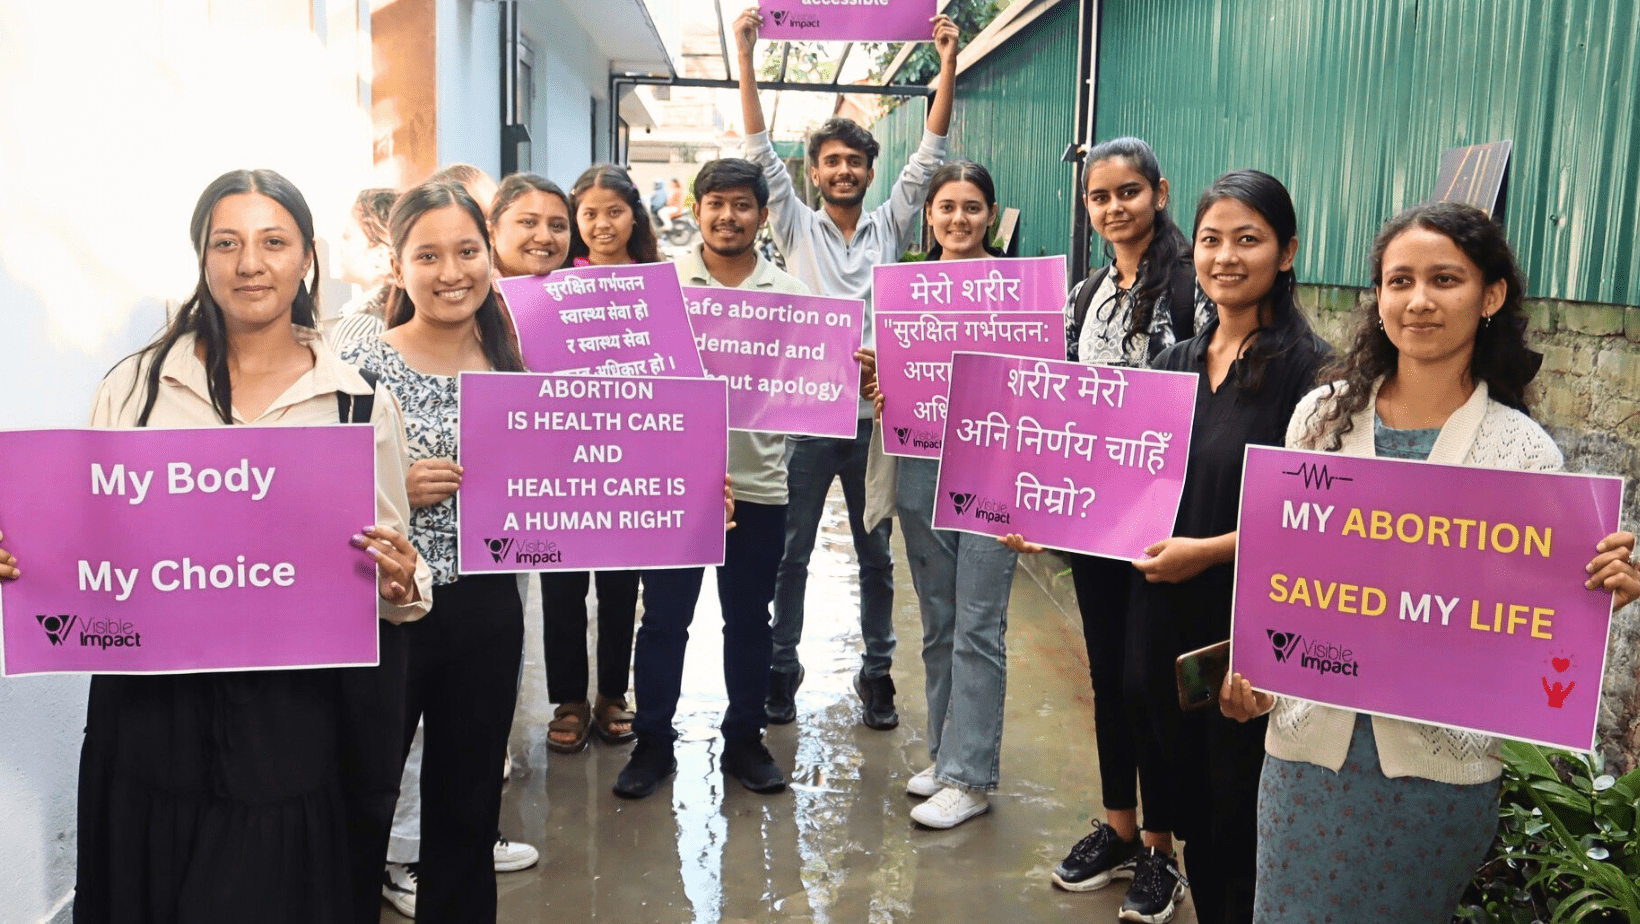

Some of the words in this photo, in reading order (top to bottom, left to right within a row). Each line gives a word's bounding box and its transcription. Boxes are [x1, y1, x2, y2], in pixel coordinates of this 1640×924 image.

[789, 20, 820, 29] Impact
[543, 275, 596, 301] सुरक्षित
[598, 273, 645, 292] गर्भपतन
[910, 272, 954, 305] मेरो
[961, 269, 1021, 303] शरीर
[558, 306, 606, 325] स्वास्थ्य
[607, 301, 632, 321] सेवा
[632, 298, 650, 321] हो
[728, 300, 819, 325] abortion
[824, 310, 852, 327] on
[963, 313, 1050, 343] गर्भपतन:
[565, 338, 577, 354] र
[577, 334, 622, 353] स्वास्थ्य
[623, 328, 651, 350] सेवा
[695, 333, 781, 357] demand
[784, 342, 826, 361] and
[647, 352, 665, 376] हो
[538, 379, 654, 400] ABORTION
[757, 376, 844, 402] apology
[1007, 362, 1071, 402] शरीर
[1078, 367, 1129, 409] मेरो
[507, 411, 529, 430] IS
[533, 411, 622, 431] HEALTH
[627, 413, 685, 432] CARE
[956, 411, 1011, 450] अनि
[1016, 415, 1098, 462] निर्णय
[573, 445, 623, 463] AND
[90, 463, 154, 505] My
[167, 458, 276, 501] Body
[507, 477, 597, 498] HEALTH
[602, 477, 661, 496] CARE
[666, 477, 687, 496] IS
[976, 497, 1008, 514] Visible
[1014, 471, 1097, 519] तिम्रो?
[502, 512, 520, 532] A
[524, 511, 613, 531] HUMAN
[618, 509, 686, 530] RIGHT
[975, 509, 1010, 525] Impact
[1281, 499, 1335, 534] MY
[1341, 507, 1553, 559] ABORTION
[516, 539, 557, 553] Visible
[516, 550, 562, 567] Impact
[77, 559, 140, 602] My
[151, 555, 296, 592] Choice
[1268, 572, 1388, 618] SAVED
[1398, 591, 1461, 628] MY
[1470, 600, 1556, 642] LIFE
[80, 616, 135, 634] Visible
[79, 631, 142, 650] Impact
[1301, 638, 1354, 662] Visible
[1300, 652, 1360, 677] Impact
